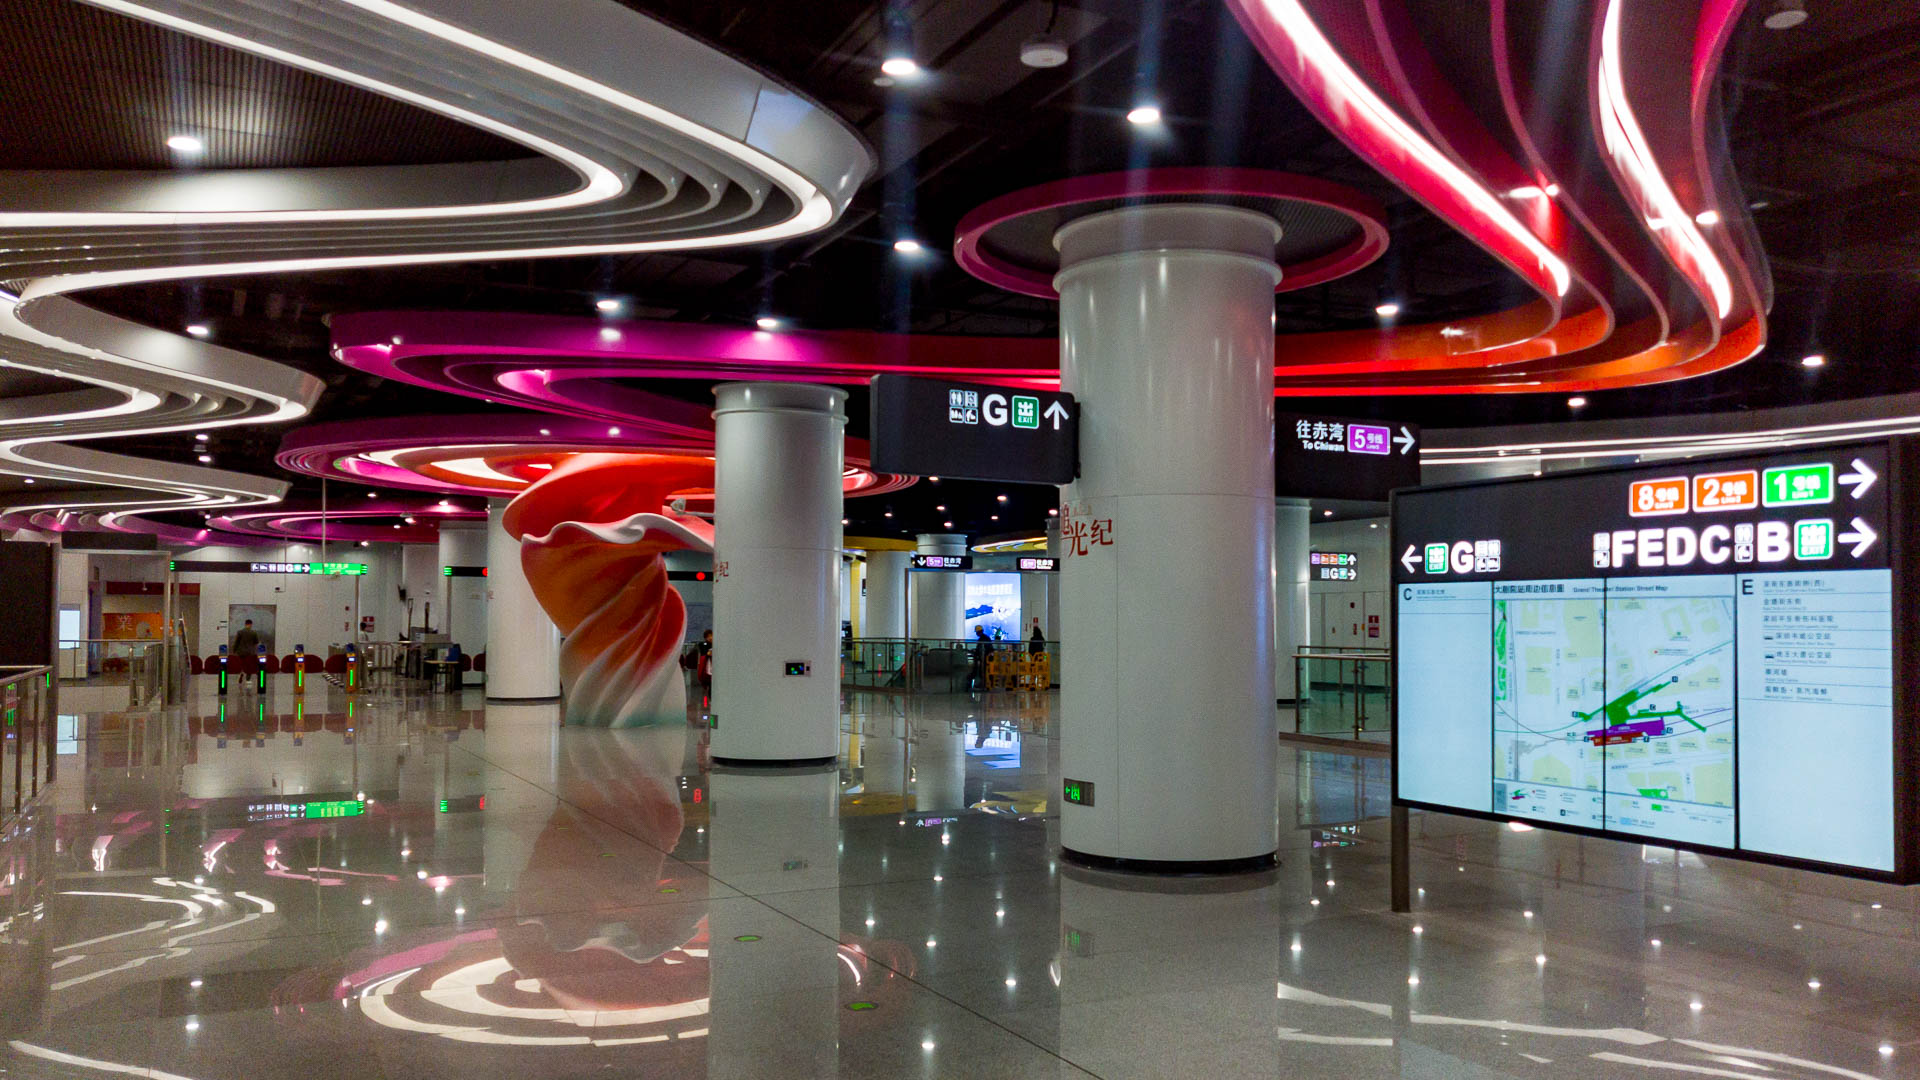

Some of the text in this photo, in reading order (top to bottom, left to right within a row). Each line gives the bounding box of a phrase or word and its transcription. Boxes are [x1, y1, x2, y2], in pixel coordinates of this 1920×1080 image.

[983, 394, 1007, 426] G
[1018, 402, 1033, 416] 出
[1018, 416, 1033, 424] EXIT
[1296, 420, 1344, 441] 往赤湾
[1302, 440, 1345, 452] To Chiwan
[1757, 521, 1790, 562] B
[1450, 541, 1474, 573] G
[1330, 568, 1338, 579] G
[1403, 588, 1413, 601] C
[1742, 579, 1754, 595] E
